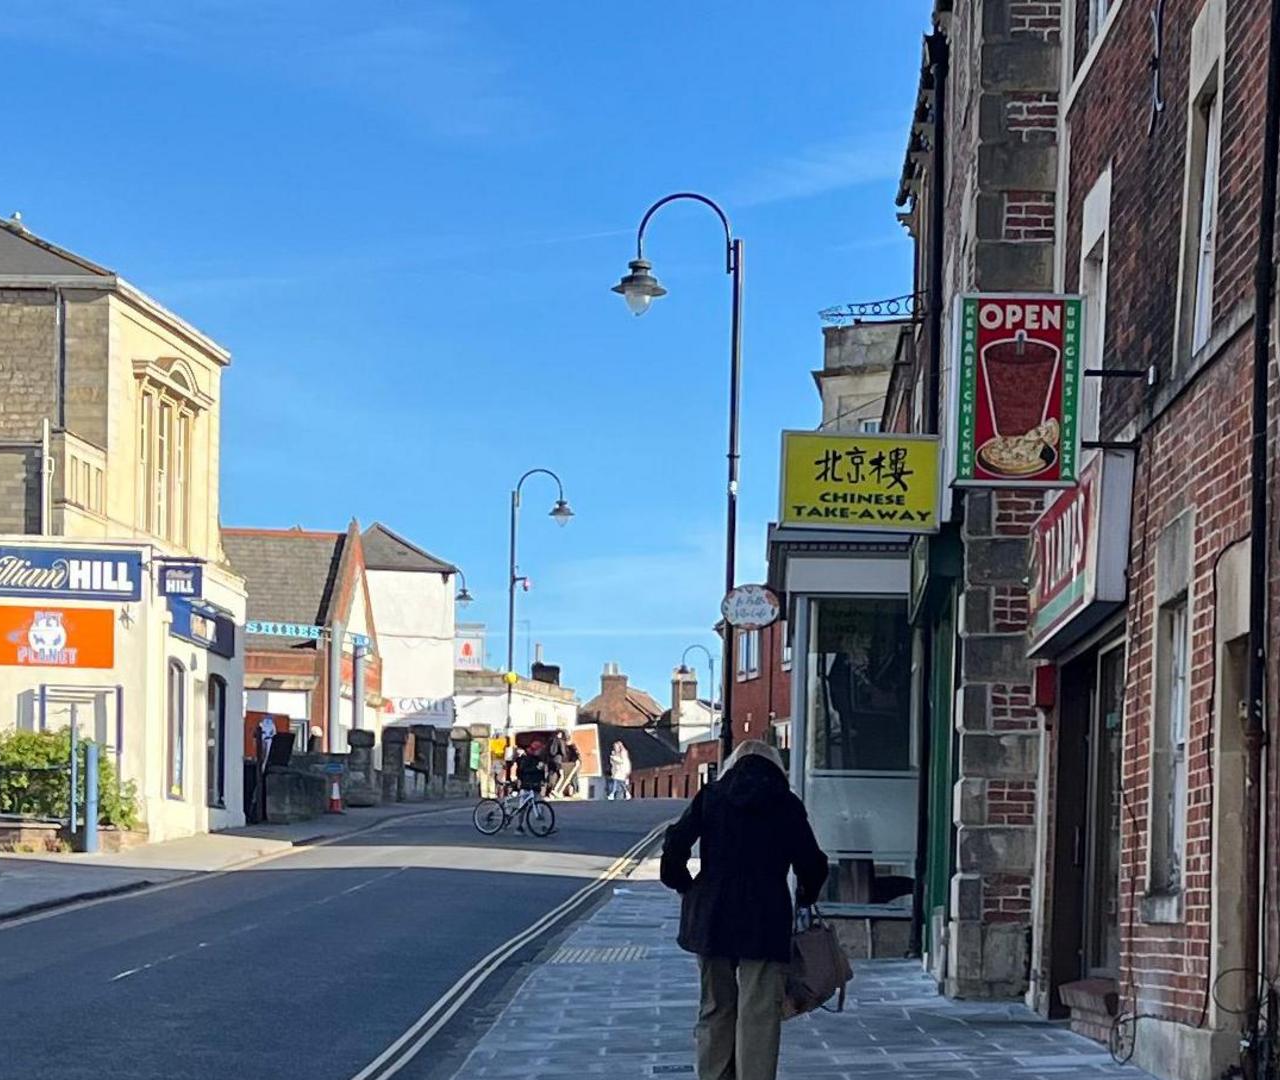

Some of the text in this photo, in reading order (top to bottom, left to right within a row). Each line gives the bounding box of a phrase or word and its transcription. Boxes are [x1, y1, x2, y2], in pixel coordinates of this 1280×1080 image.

[979, 303, 1061, 330] OPEN
[961, 305, 975, 476] KEBABS CHICKEN
[1062, 306, 1076, 477] BURGERS PIZZA
[814, 446, 914, 492] 北京樓
[819, 492, 906, 506] CHINESE
[792, 505, 932, 522] TAKE-AWAY
[69, 559, 134, 592] HILL
[166, 579, 195, 594] HILL
[34, 610, 64, 628] PET
[245, 622, 320, 639] SHIRES
[17, 646, 78, 665] PLANET
